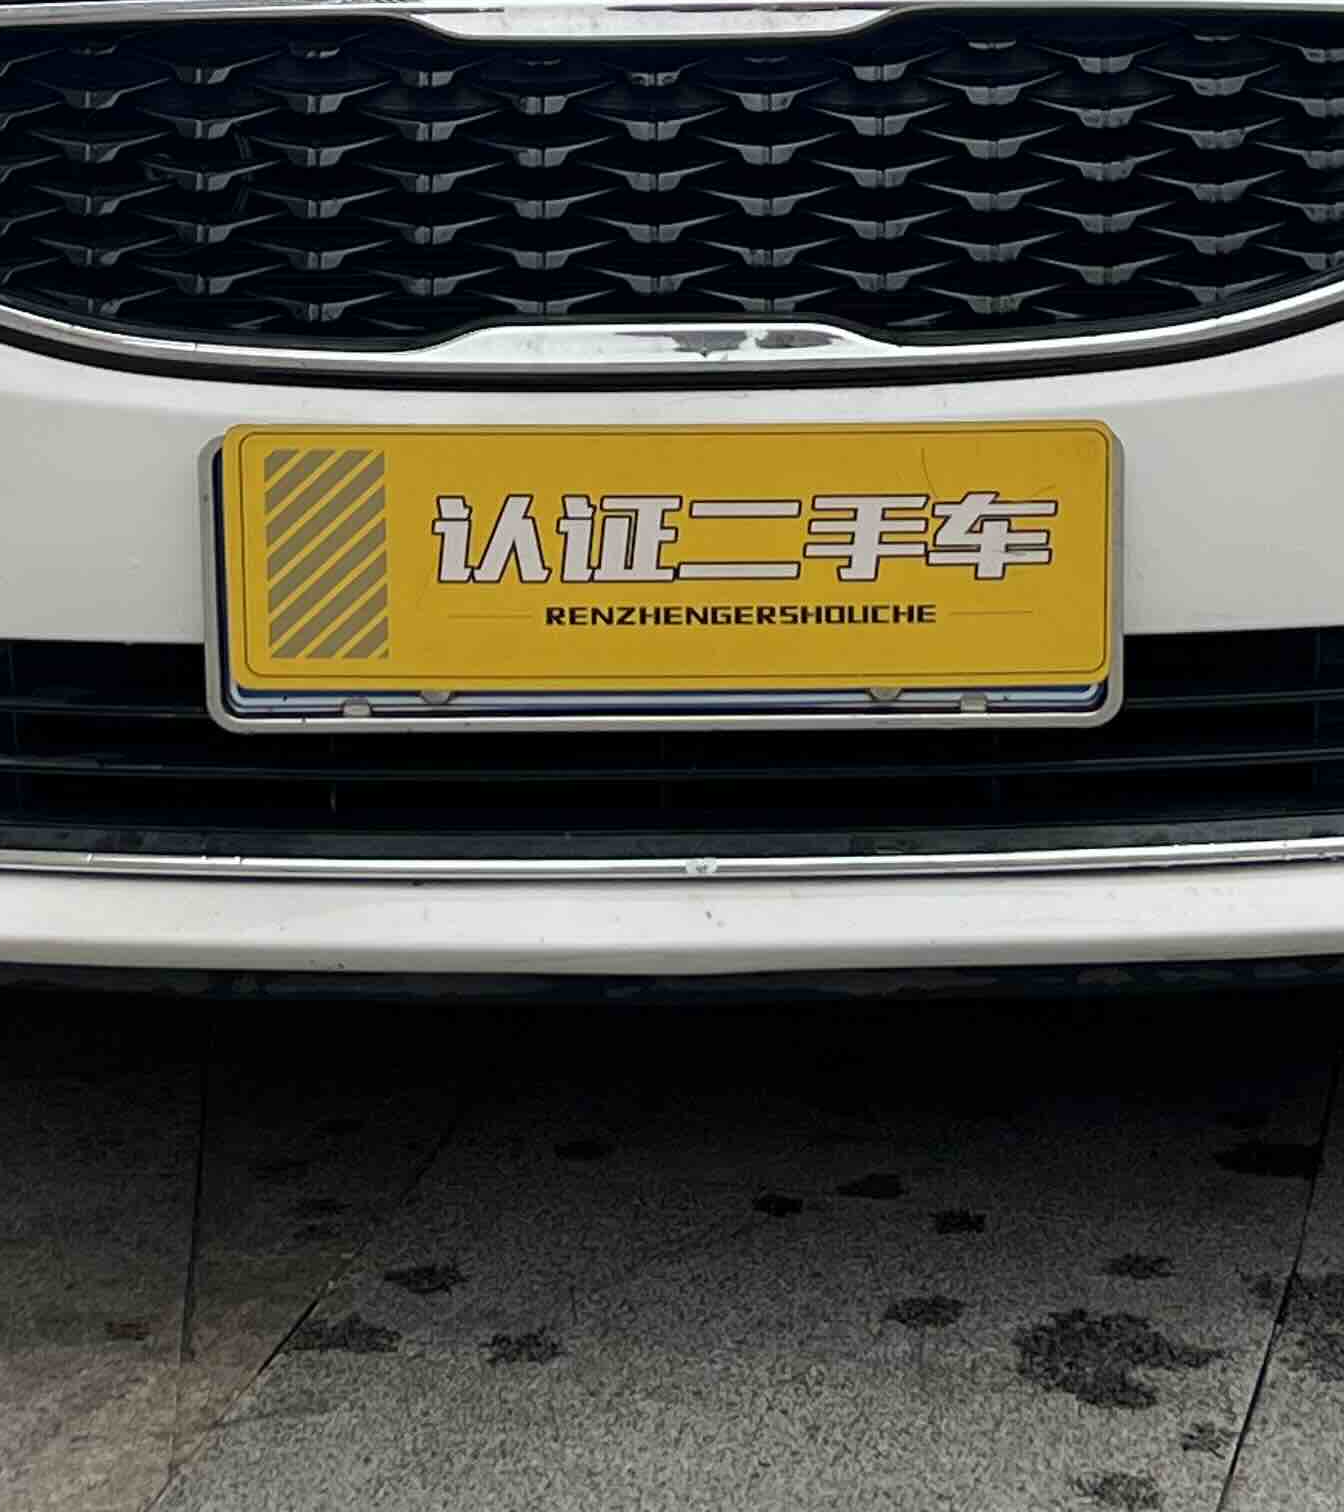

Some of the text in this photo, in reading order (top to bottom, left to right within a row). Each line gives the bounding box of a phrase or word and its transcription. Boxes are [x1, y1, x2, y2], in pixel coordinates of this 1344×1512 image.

[432, 491, 1058, 583] 认证二手车
[545, 604, 936, 626] RENZHENGERSHOUCHE
